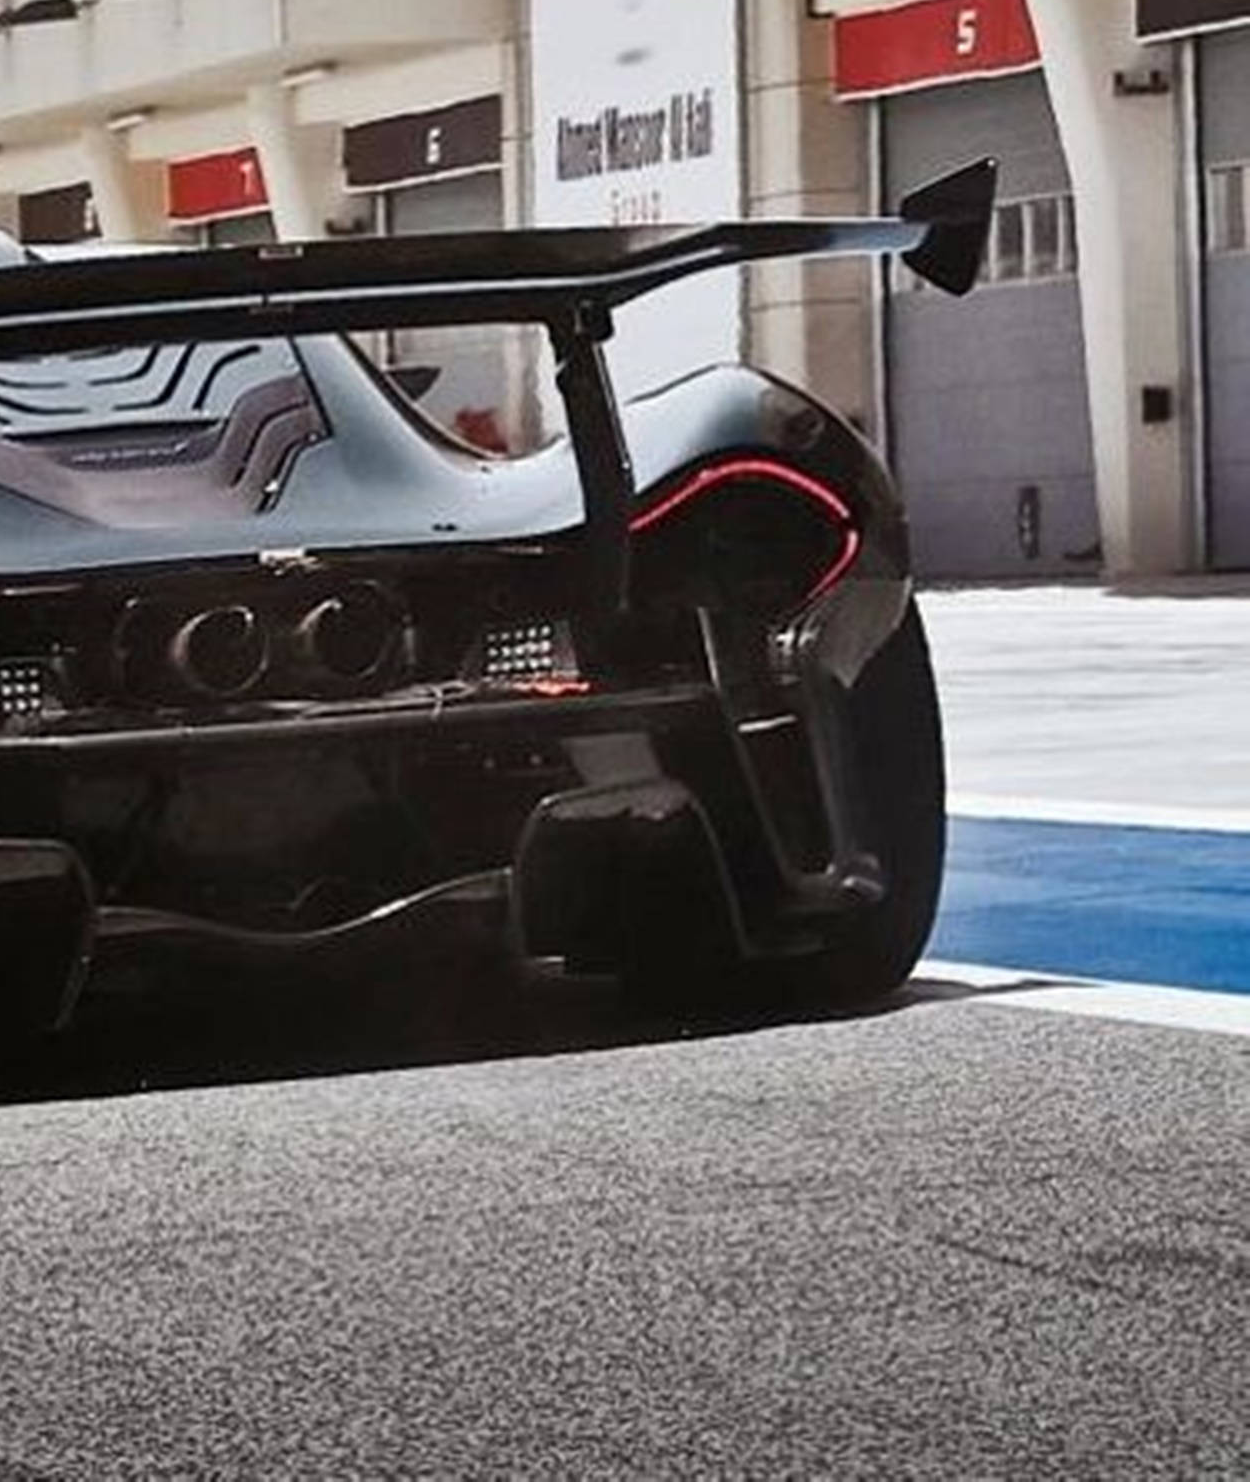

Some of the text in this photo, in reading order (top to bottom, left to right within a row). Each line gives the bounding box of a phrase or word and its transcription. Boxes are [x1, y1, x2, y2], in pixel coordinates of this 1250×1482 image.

[956, 8, 978, 55] 5
[426, 125, 442, 166] 6
[239, 160, 253, 196] 7
